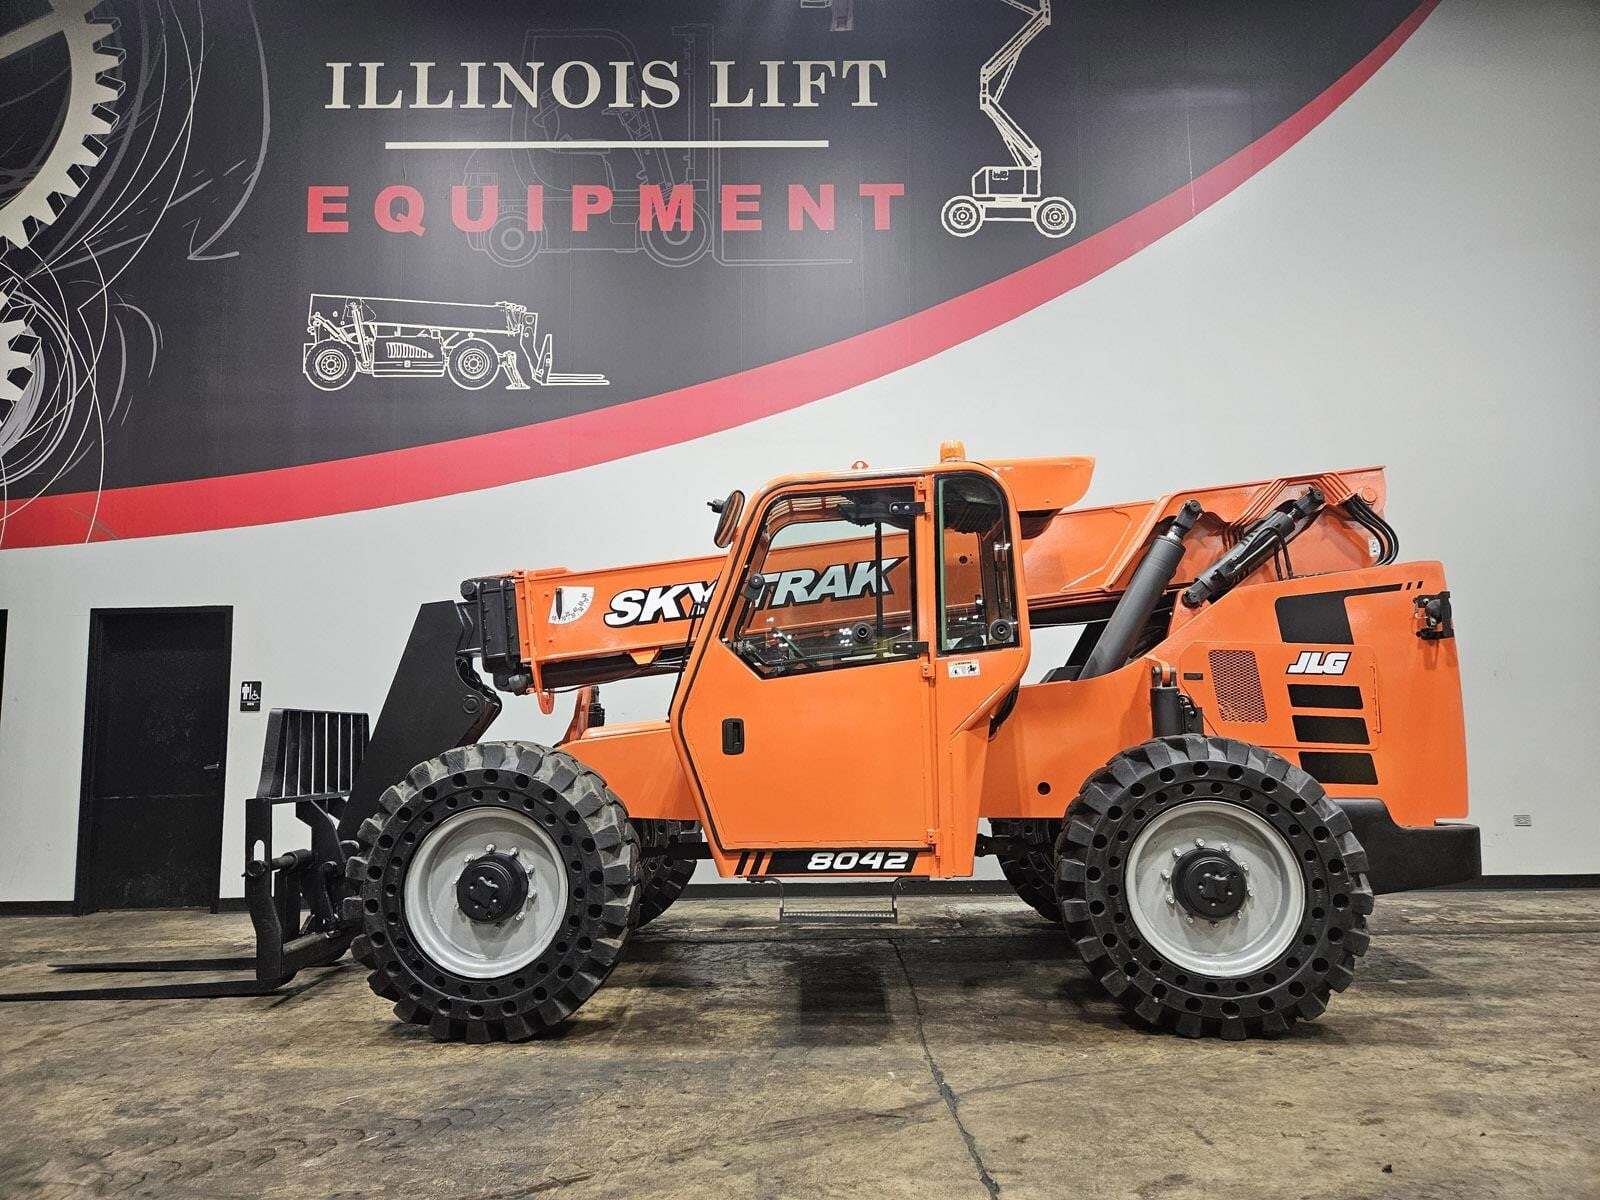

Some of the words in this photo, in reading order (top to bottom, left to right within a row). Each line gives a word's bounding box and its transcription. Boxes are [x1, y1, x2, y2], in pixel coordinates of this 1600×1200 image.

[325, 60, 681, 110] ILLINOIS
[710, 59, 888, 108] LIFT
[306, 183, 906, 236] EQUIPMENT
[1286, 651, 1352, 675] JLG
[807, 851, 910, 870] 8042
